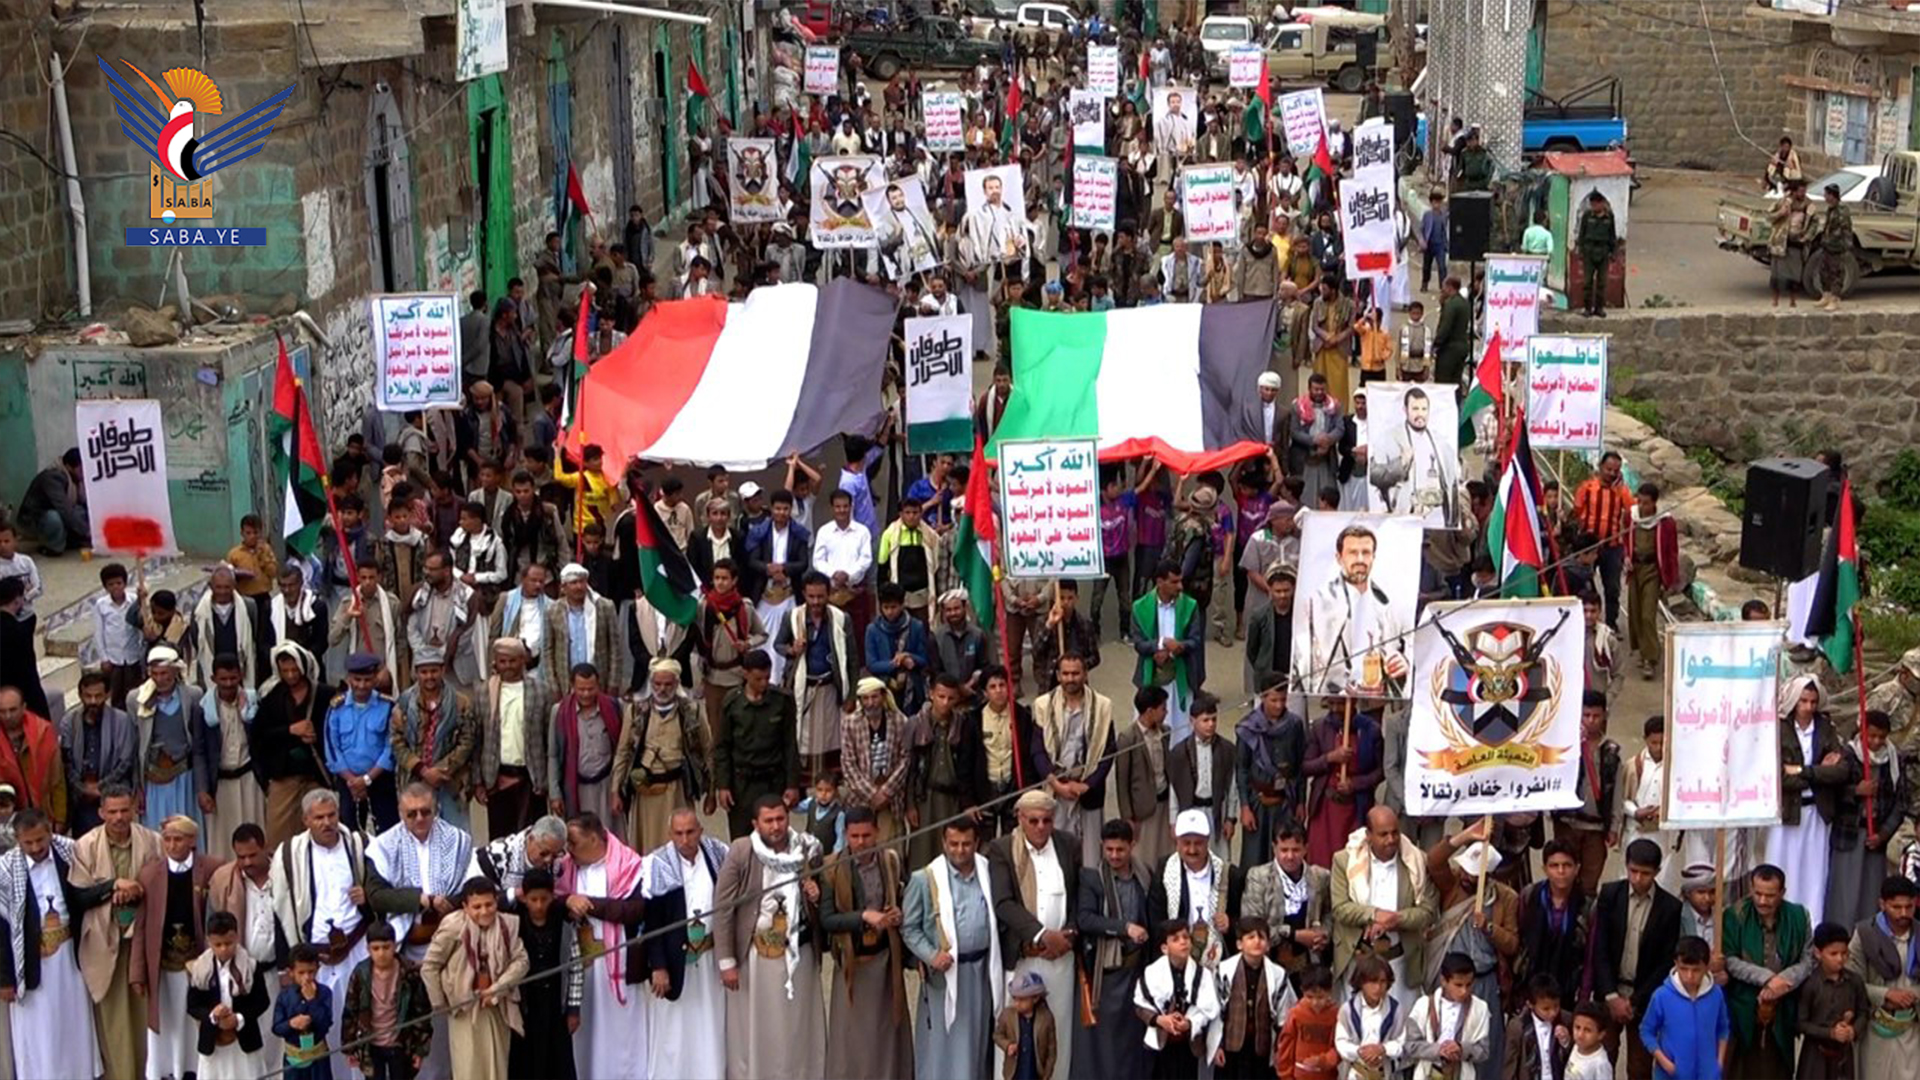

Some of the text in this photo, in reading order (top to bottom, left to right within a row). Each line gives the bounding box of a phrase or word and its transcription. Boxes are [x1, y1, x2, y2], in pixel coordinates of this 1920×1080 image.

[427, 301, 451, 319] الله
[910, 330, 962, 366] طوفان
[1532, 346, 1600, 369] قاطعوا
[426, 378, 454, 398] النصر
[87, 417, 153, 459] طوفان
[1008, 446, 1091, 479] الله أكبر
[1056, 480, 1092, 498] الموت
[1057, 504, 1094, 522] الموت
[1045, 528, 1062, 545] على
[1060, 546, 1096, 571] النصر
